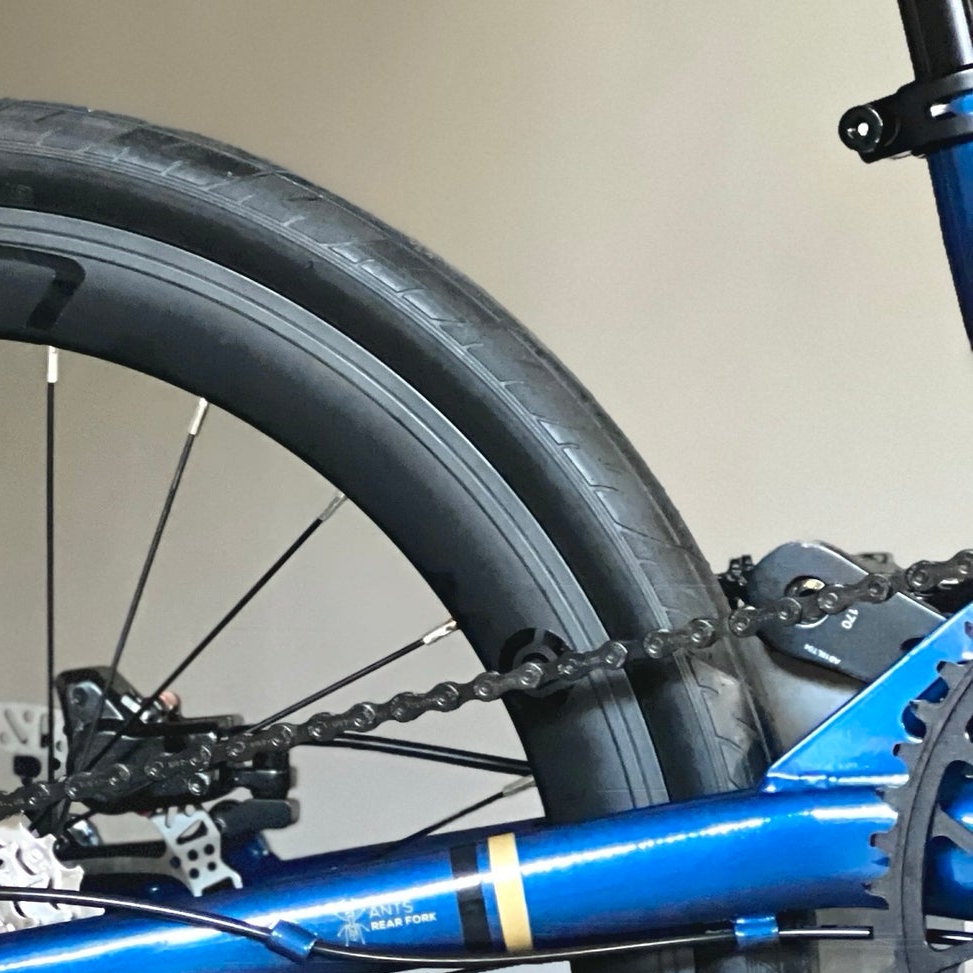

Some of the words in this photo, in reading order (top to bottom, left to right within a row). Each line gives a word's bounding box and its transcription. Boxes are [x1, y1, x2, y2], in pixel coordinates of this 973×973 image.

[841, 608, 859, 629] 170
[369, 900, 414, 919] ANTS
[370, 917, 403, 931] REAR
[404, 912, 437, 925] FORK
